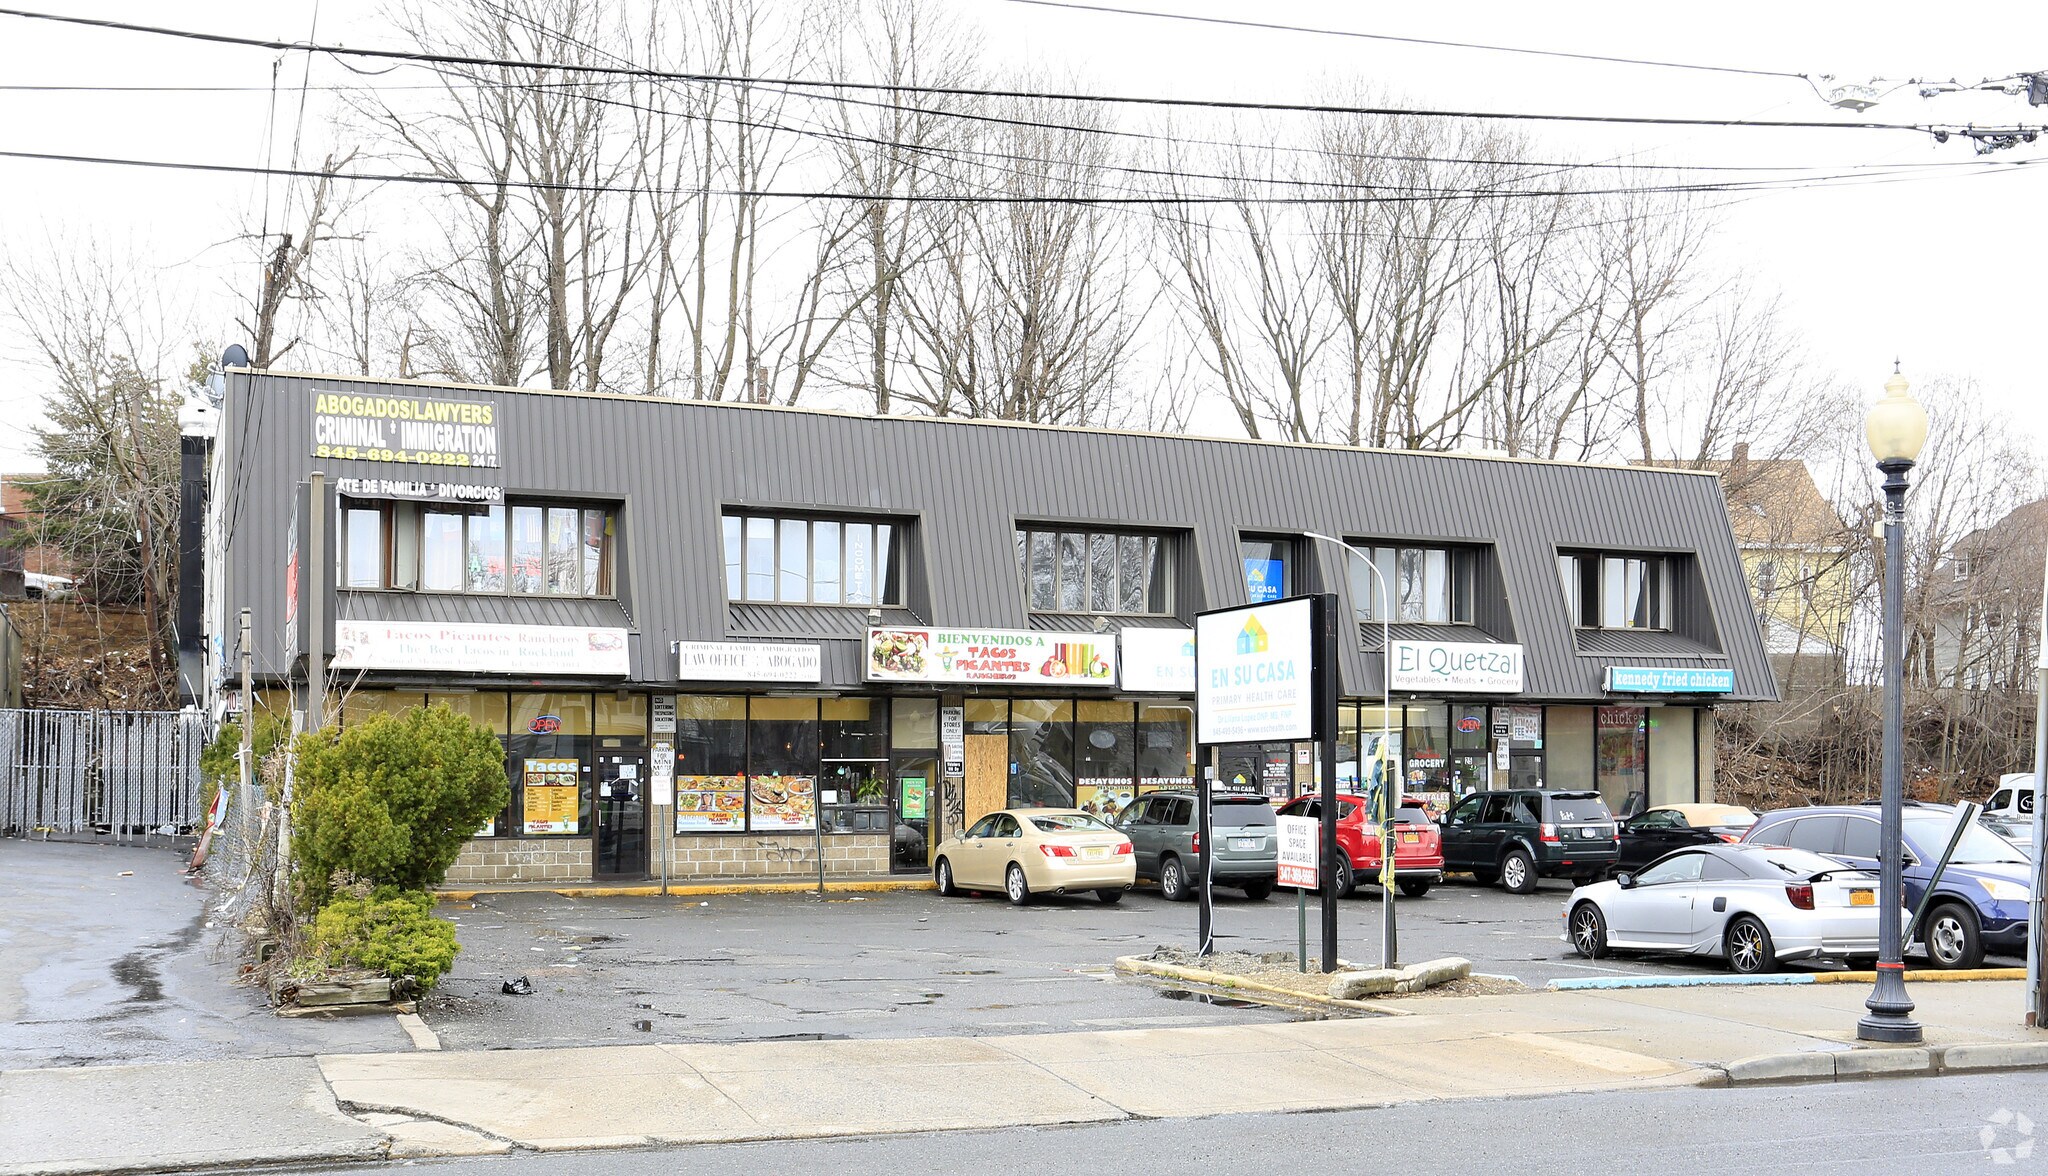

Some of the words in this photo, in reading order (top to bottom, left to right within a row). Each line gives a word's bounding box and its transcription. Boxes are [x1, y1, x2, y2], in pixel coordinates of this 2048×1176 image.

[315, 393, 493, 425] ABOGADOS/LAWYERS
[315, 415, 387, 448] CRIMINAL
[400, 421, 497, 454] IMMIGRATION
[316, 445, 470, 466] 845-694-0222
[362, 479, 378, 494] DE
[380, 479, 427, 496] FAMILIA
[438, 484, 501, 501] DIVORCIOS
[1257, 585, 1277, 594] CASA
[386, 628, 433, 641] Tacos
[439, 630, 511, 642] Picantes
[518, 633, 580, 644] Rancheros
[937, 633, 1032, 647] BIENVENIDOS
[1035, 637, 1045, 647] A
[430, 645, 455, 656] Best
[519, 647, 574, 658] Rockland
[967, 646, 1016, 659] TACOS
[684, 653, 706, 666] LAW
[709, 653, 747, 667] OFFICE
[768, 655, 817, 668] ABOGADO
[956, 659, 1030, 672] PICANTES
[1398, 646, 1420, 672] El
[1429, 648, 1517, 676] Quetzal
[1156, 665, 1174, 678] EN
[1211, 667, 1229, 689] EN
[1234, 664, 1252, 686] SU
[1256, 659, 1295, 684] CASA
[1395, 675, 1441, 685] Vegetables
[1451, 676, 1477, 685] Meats
[1487, 677, 1519, 686] Grocery
[1615, 671, 1661, 689] kennedy
[1662, 672, 1688, 687] fried
[1690, 673, 1730, 687] chicken
[1211, 693, 1242, 706] PRIMARY
[1246, 691, 1274, 703] HEALTH
[1277, 688, 1297, 699] CARE
[1600, 710, 1645, 725] chicken
[529, 717, 560, 732] OPEN
[1457, 718, 1481, 731] OPEN
[1514, 727, 1525, 736] FEE
[526, 760, 578, 772] Tacos
[1409, 758, 1446, 768] GROCERY
[1078, 777, 1132, 785] DESAYUNOS
[1140, 777, 1193, 785] DESAYUNOS
[1287, 824, 1307, 836] OFFICE
[1288, 837, 1306, 849] SPACE
[1282, 851, 1312, 863] AVAILABLE
